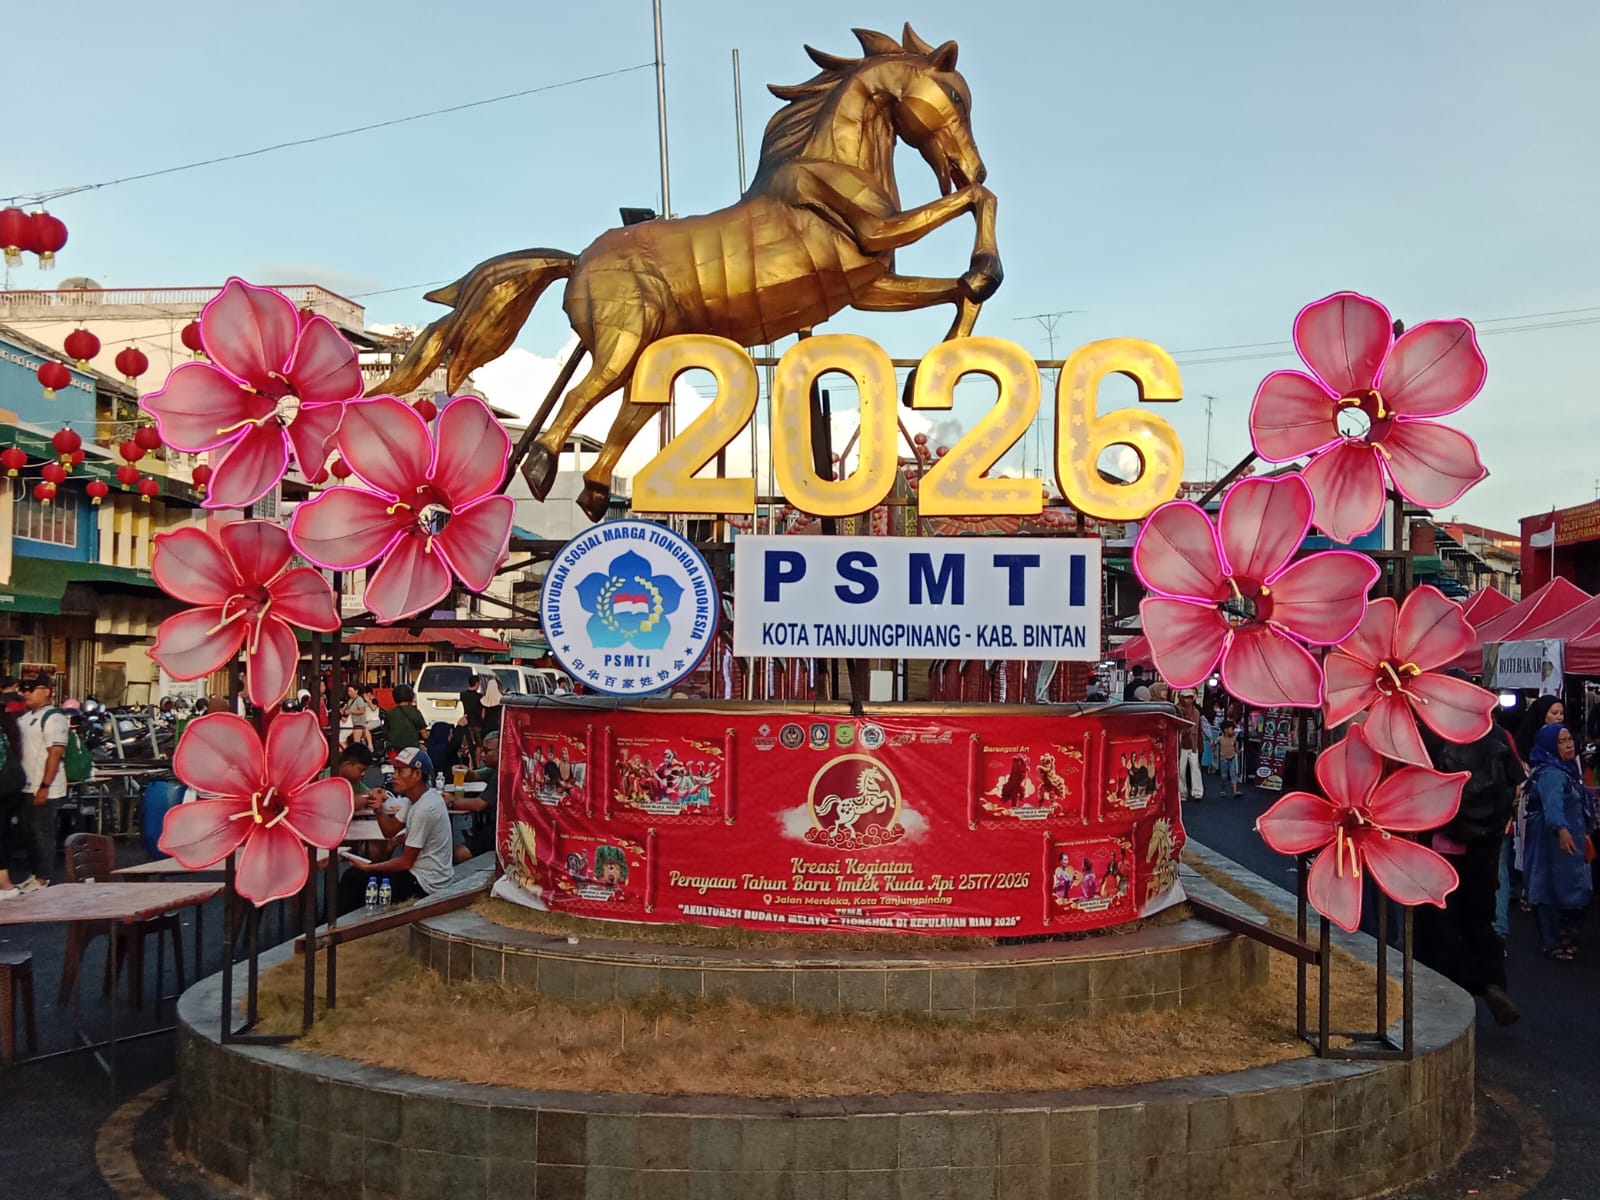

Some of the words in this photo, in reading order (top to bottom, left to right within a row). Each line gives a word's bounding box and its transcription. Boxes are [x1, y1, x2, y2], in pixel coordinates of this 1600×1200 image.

[631, 333, 1184, 520] 2026
[547, 565, 571, 638] PAGUYUBAN
[564, 535, 603, 566] SOSIAL
[603, 527, 646, 542] MARGA
[648, 530, 699, 577] TIONGHOA
[690, 575, 711, 641] INDONESIA
[763, 550, 1086, 606] PSMTI
[762, 623, 809, 646] KOTA
[814, 624, 961, 647] TANJUNGPINANG
[977, 624, 1017, 647] KAB.
[1024, 625, 1086, 648] BINTAN
[604, 654, 650, 668] PSMTI
[791, 857, 840, 874] Kreasi
[845, 857, 914, 880] Kegiatan
[669, 870, 737, 895] Perayaan
[742, 873, 787, 890] Tahun
[792, 875, 831, 891] Baru
[836, 875, 879, 891] Imlek
[884, 875, 925, 891] Kuda
[928, 874, 954, 897] Api
[959, 872, 1030, 890] 2577/2026
[775, 895, 802, 904] Jalan
[805, 897, 851, 906] Merdeka,
[880, 896, 953, 906] Tanjungpinang
[744, 911, 786, 922] BUDAYA
[788, 915, 829, 925] MELAYU
[841, 917, 894, 927] TIONGHOA
[896, 918, 908, 927] DI
[910, 917, 967, 928] KEPULAUAN
[969, 917, 992, 927] RIAU
